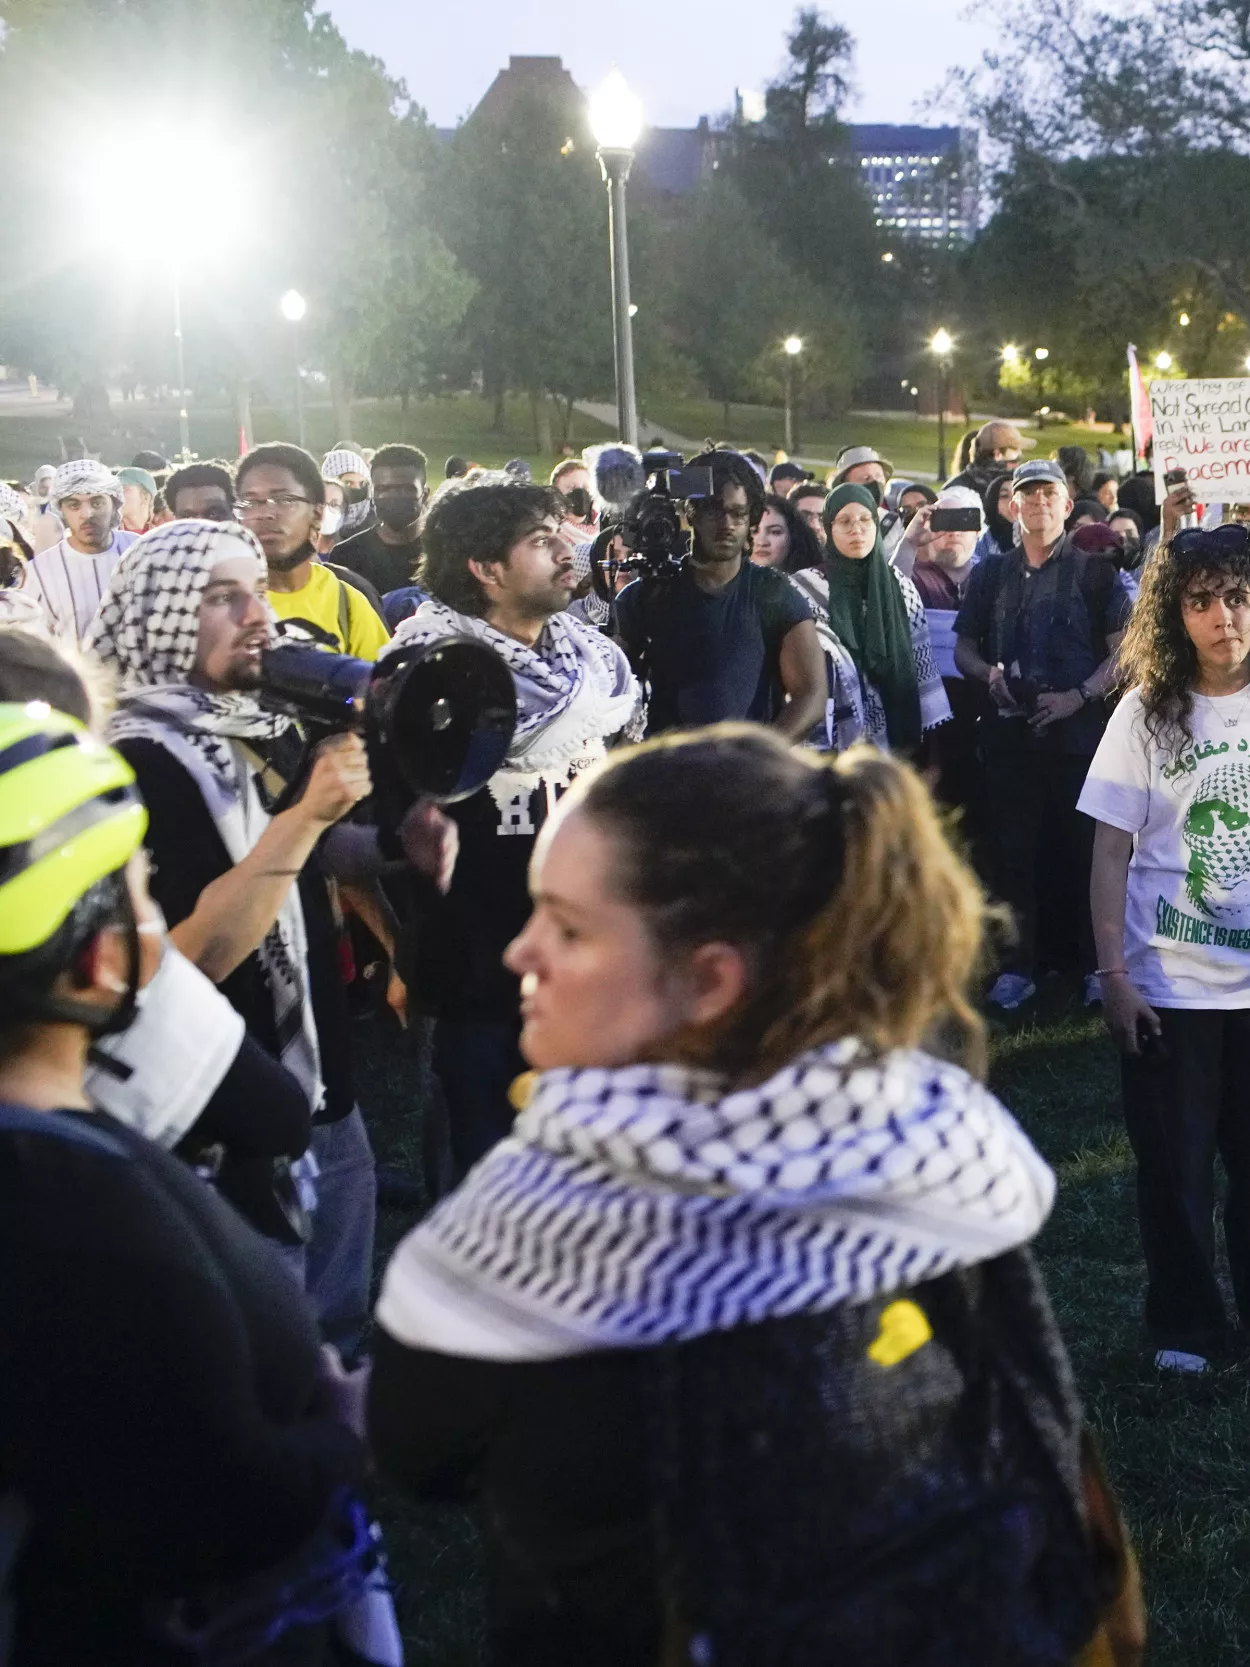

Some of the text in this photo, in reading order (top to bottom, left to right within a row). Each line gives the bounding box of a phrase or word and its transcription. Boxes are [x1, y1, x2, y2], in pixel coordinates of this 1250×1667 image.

[1151, 396, 1180, 418] Not
[1185, 393, 1242, 420] Spread
[1155, 420, 1174, 435] in
[1183, 419, 1211, 433] the
[1156, 894, 1214, 945] EXISTENCE
[1213, 922, 1228, 946] IS
